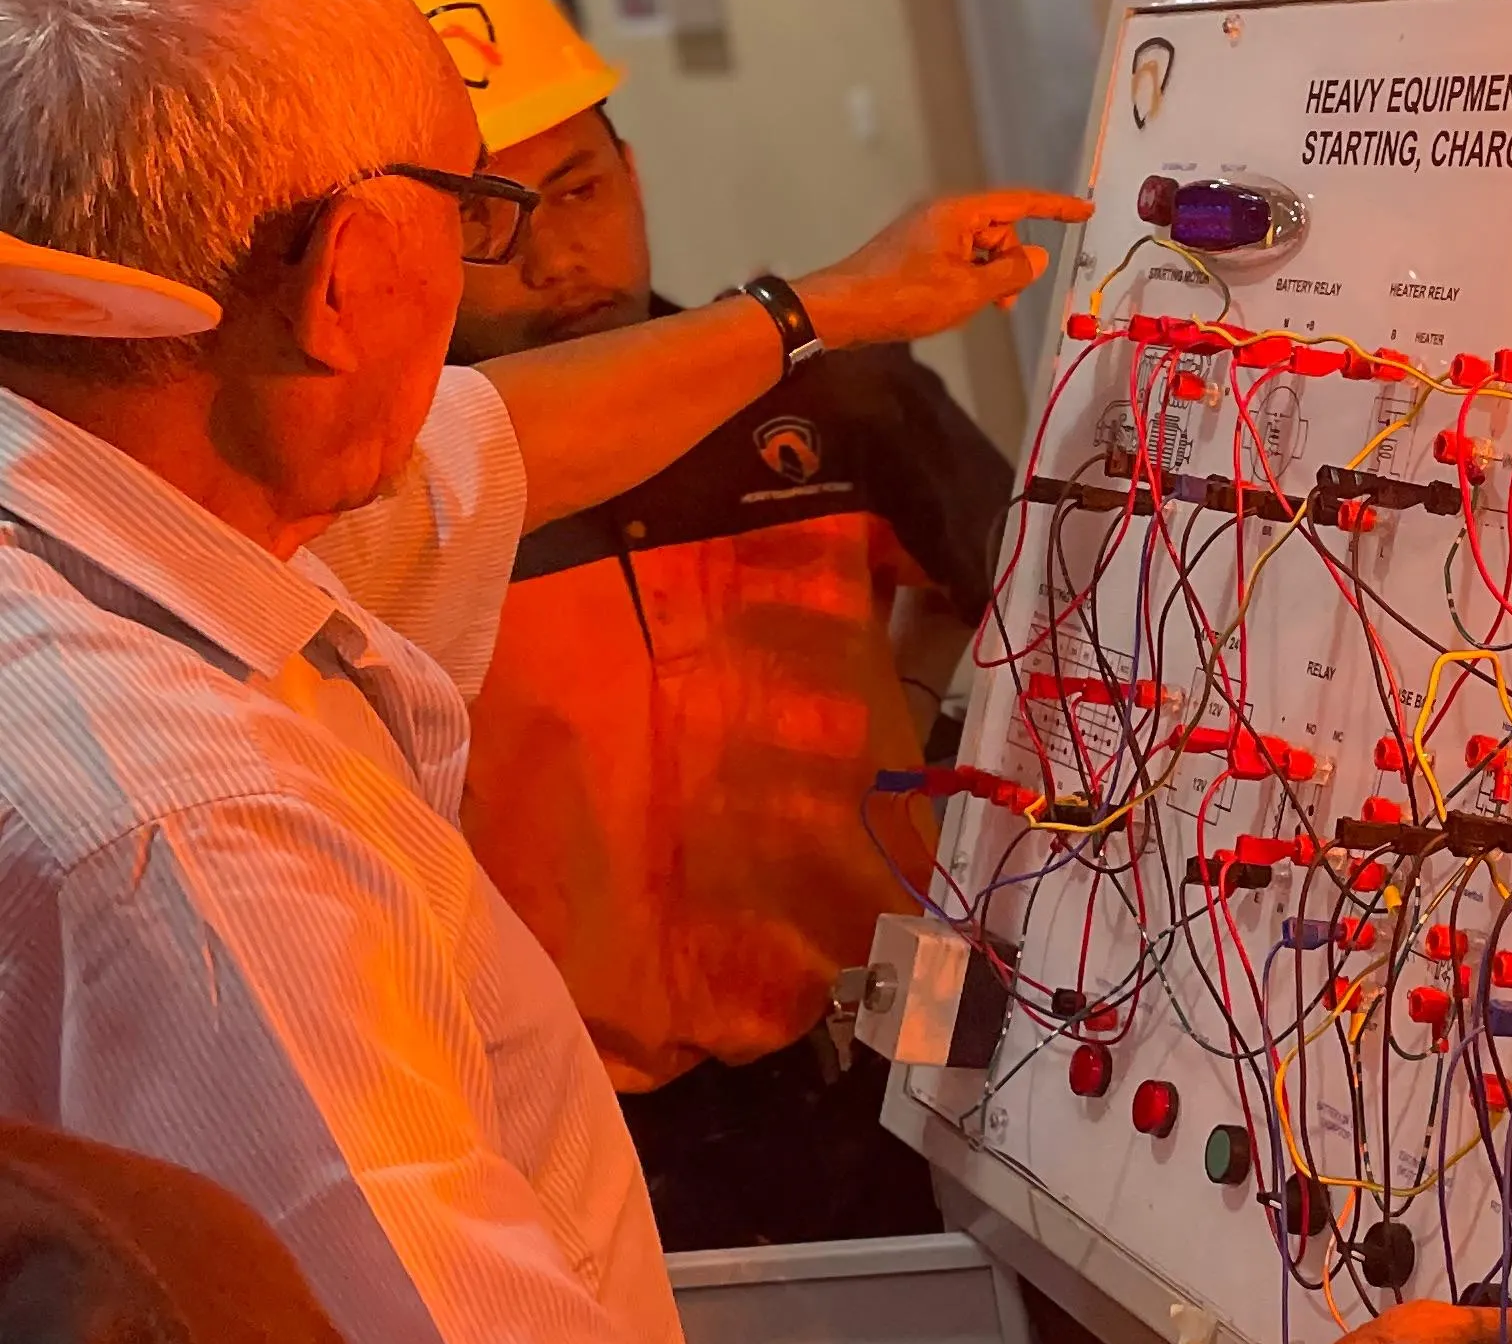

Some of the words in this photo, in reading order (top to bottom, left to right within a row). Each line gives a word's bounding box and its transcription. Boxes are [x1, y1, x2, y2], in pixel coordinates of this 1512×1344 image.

[1306, 78, 1385, 114] HEAVY
[1302, 130, 1421, 173] STARTING,
[1276, 277, 1313, 295] BATTERY
[1313, 281, 1342, 296] RELAY
[1390, 282, 1426, 299] HEATER
[1428, 285, 1460, 302] RELAY
[1414, 332, 1444, 346] HEATER
[1306, 660, 1336, 682] RELAY
[1208, 702, 1223, 718] 12V
